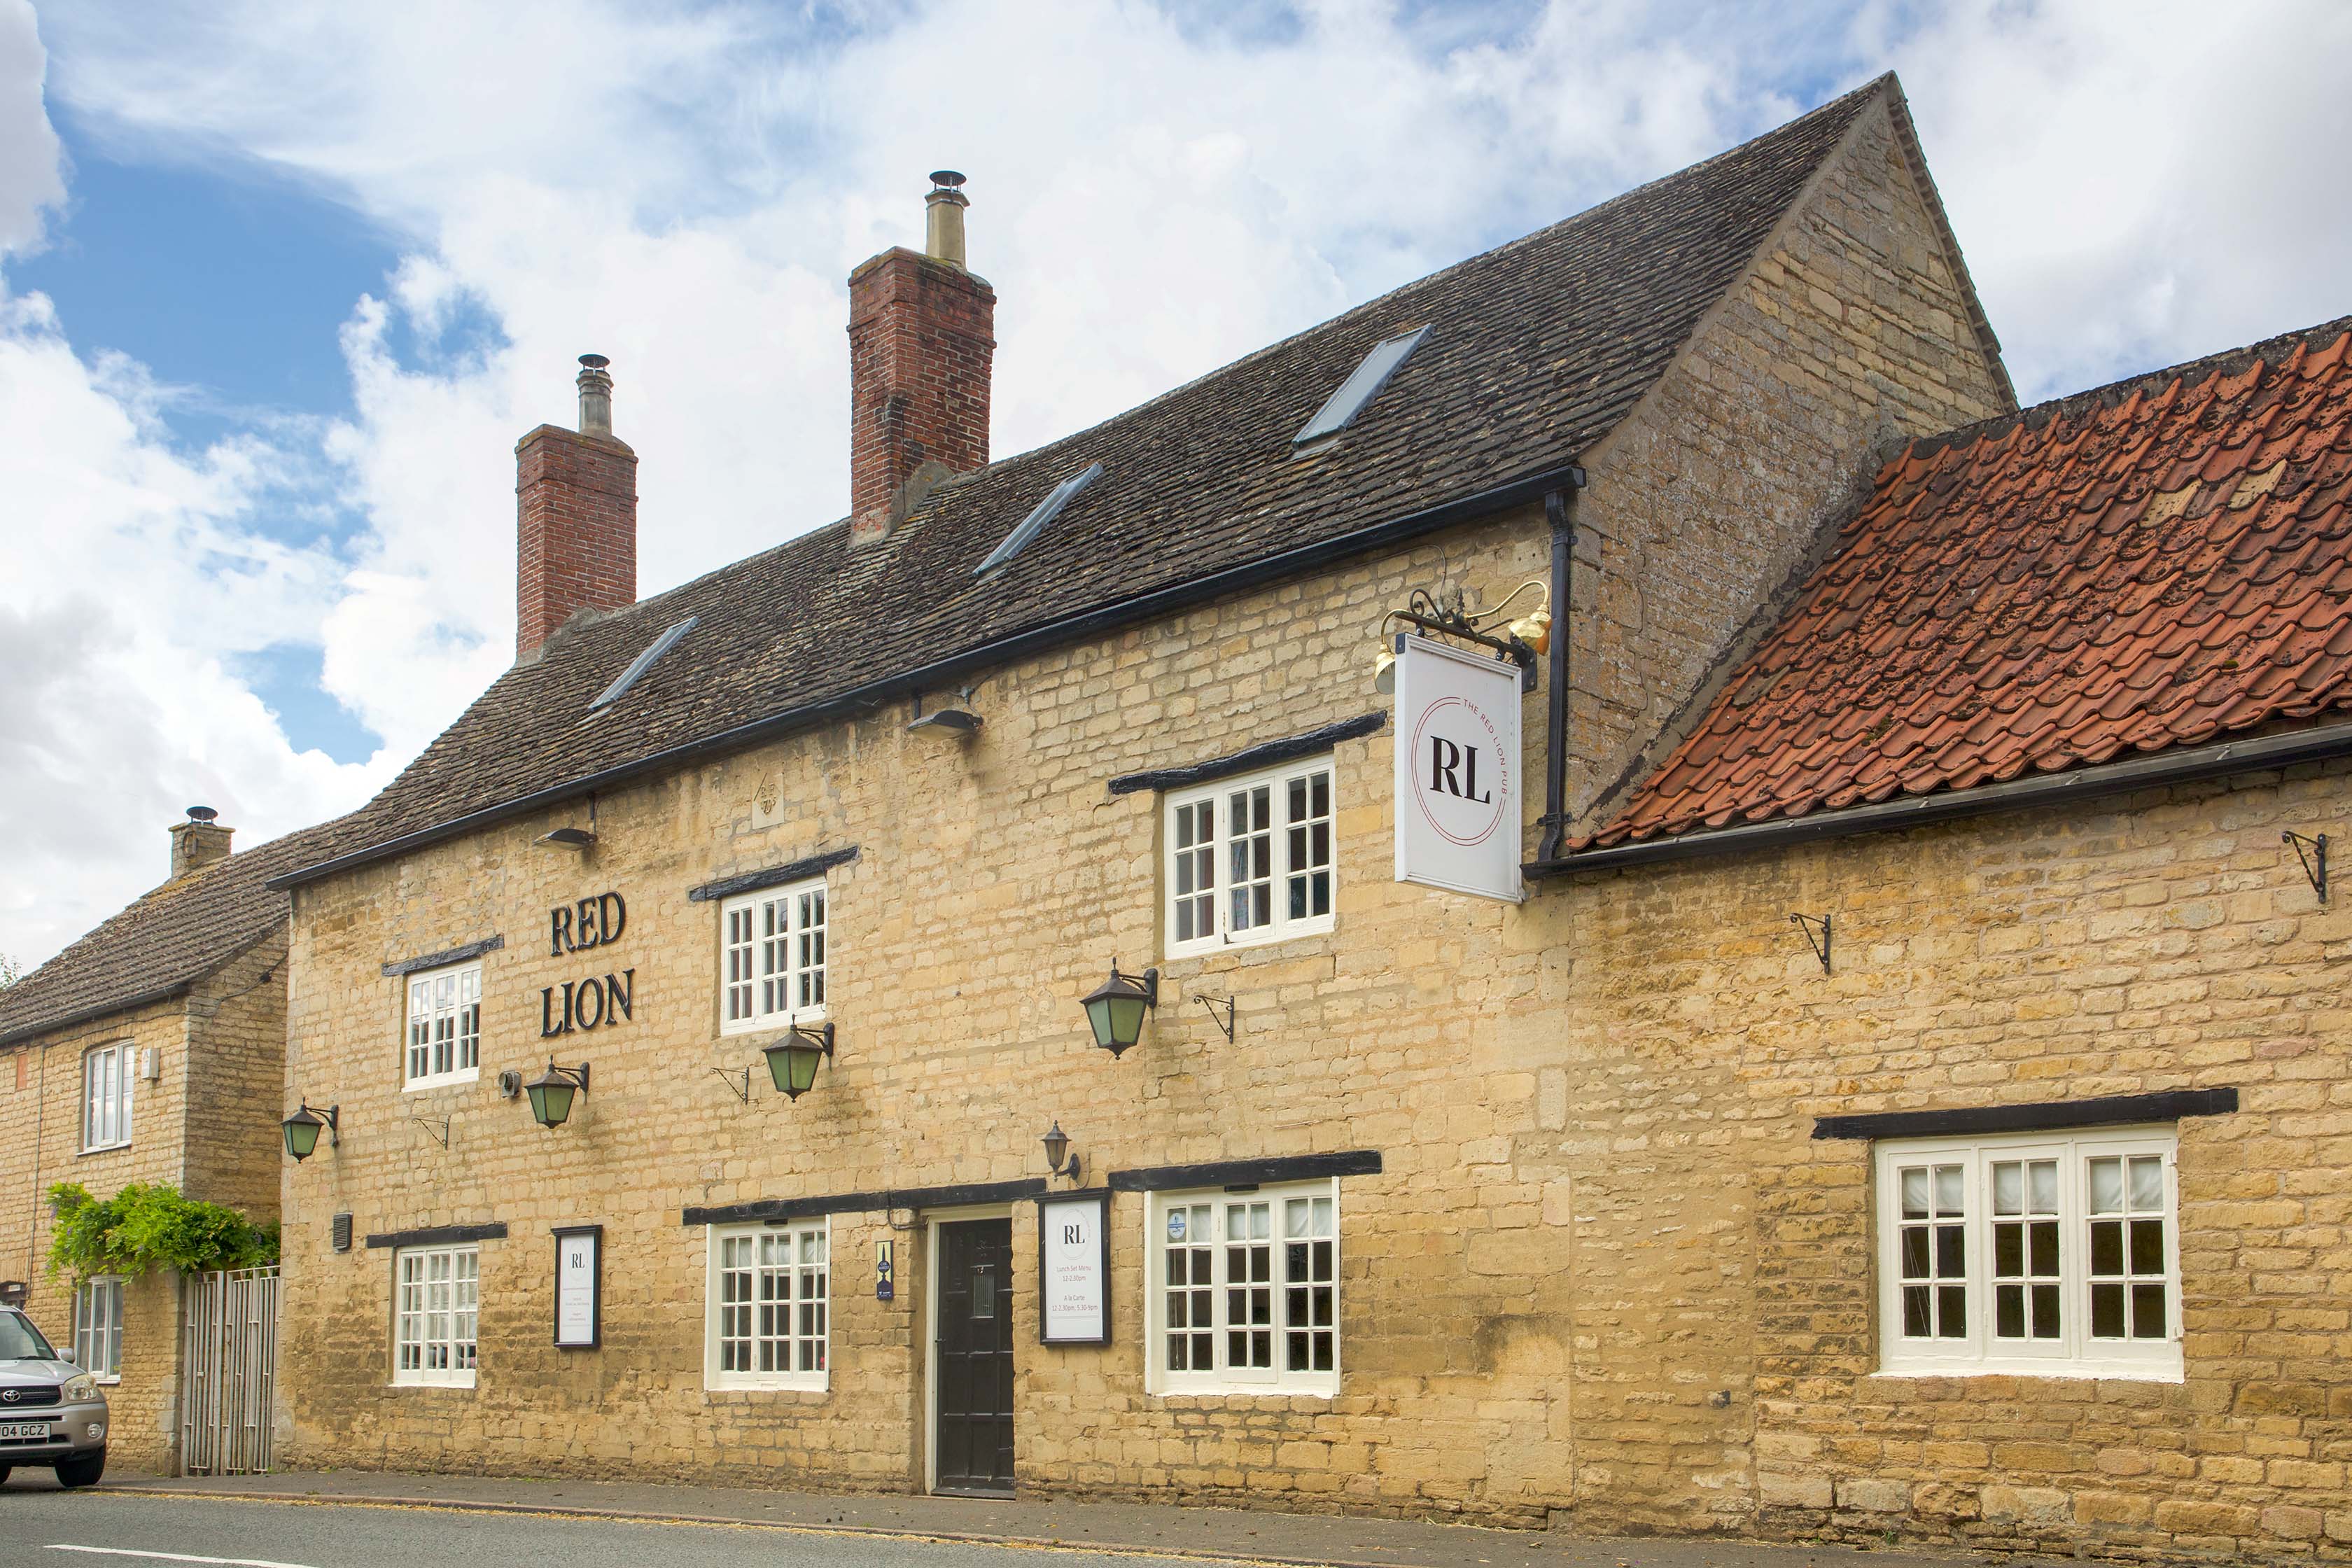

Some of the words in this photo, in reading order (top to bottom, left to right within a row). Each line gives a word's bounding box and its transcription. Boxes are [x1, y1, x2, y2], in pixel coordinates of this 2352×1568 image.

[1464, 699, 1478, 715] THE
[1480, 713, 1494, 734] RED
[1493, 736, 1506, 766] LION
[1429, 735, 1490, 804] RL
[551, 890, 626, 957] RED
[540, 968, 635, 1037] LION
[572, 1253, 585, 1268] RL
[1064, 1225, 1085, 1244] RL
[0, 1426, 17, 1436] 04
[21, 1425, 45, 1436] GCZ
